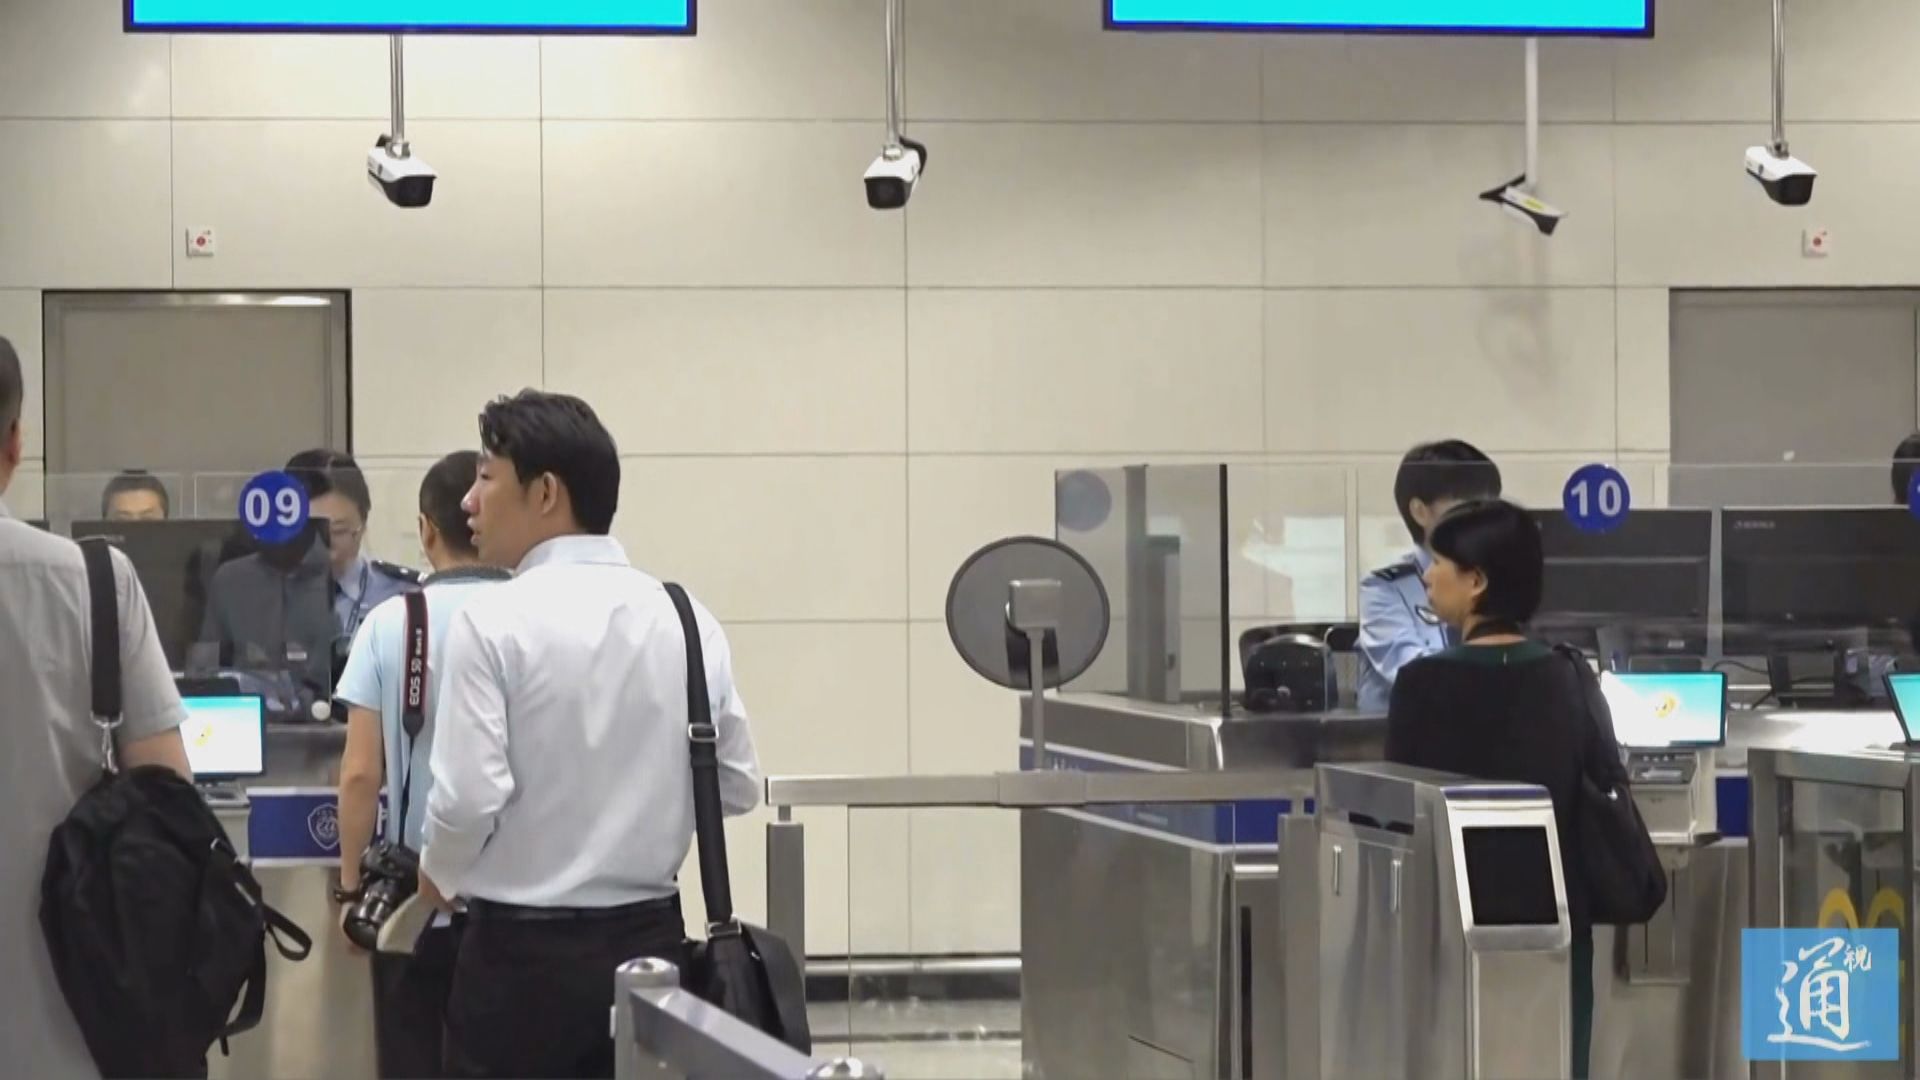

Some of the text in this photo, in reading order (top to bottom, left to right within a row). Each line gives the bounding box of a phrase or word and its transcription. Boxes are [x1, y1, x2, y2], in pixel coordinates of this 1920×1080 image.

[245, 487, 301, 527] 09
[1571, 479, 1622, 517] 10
[409, 676, 420, 706] EOS
